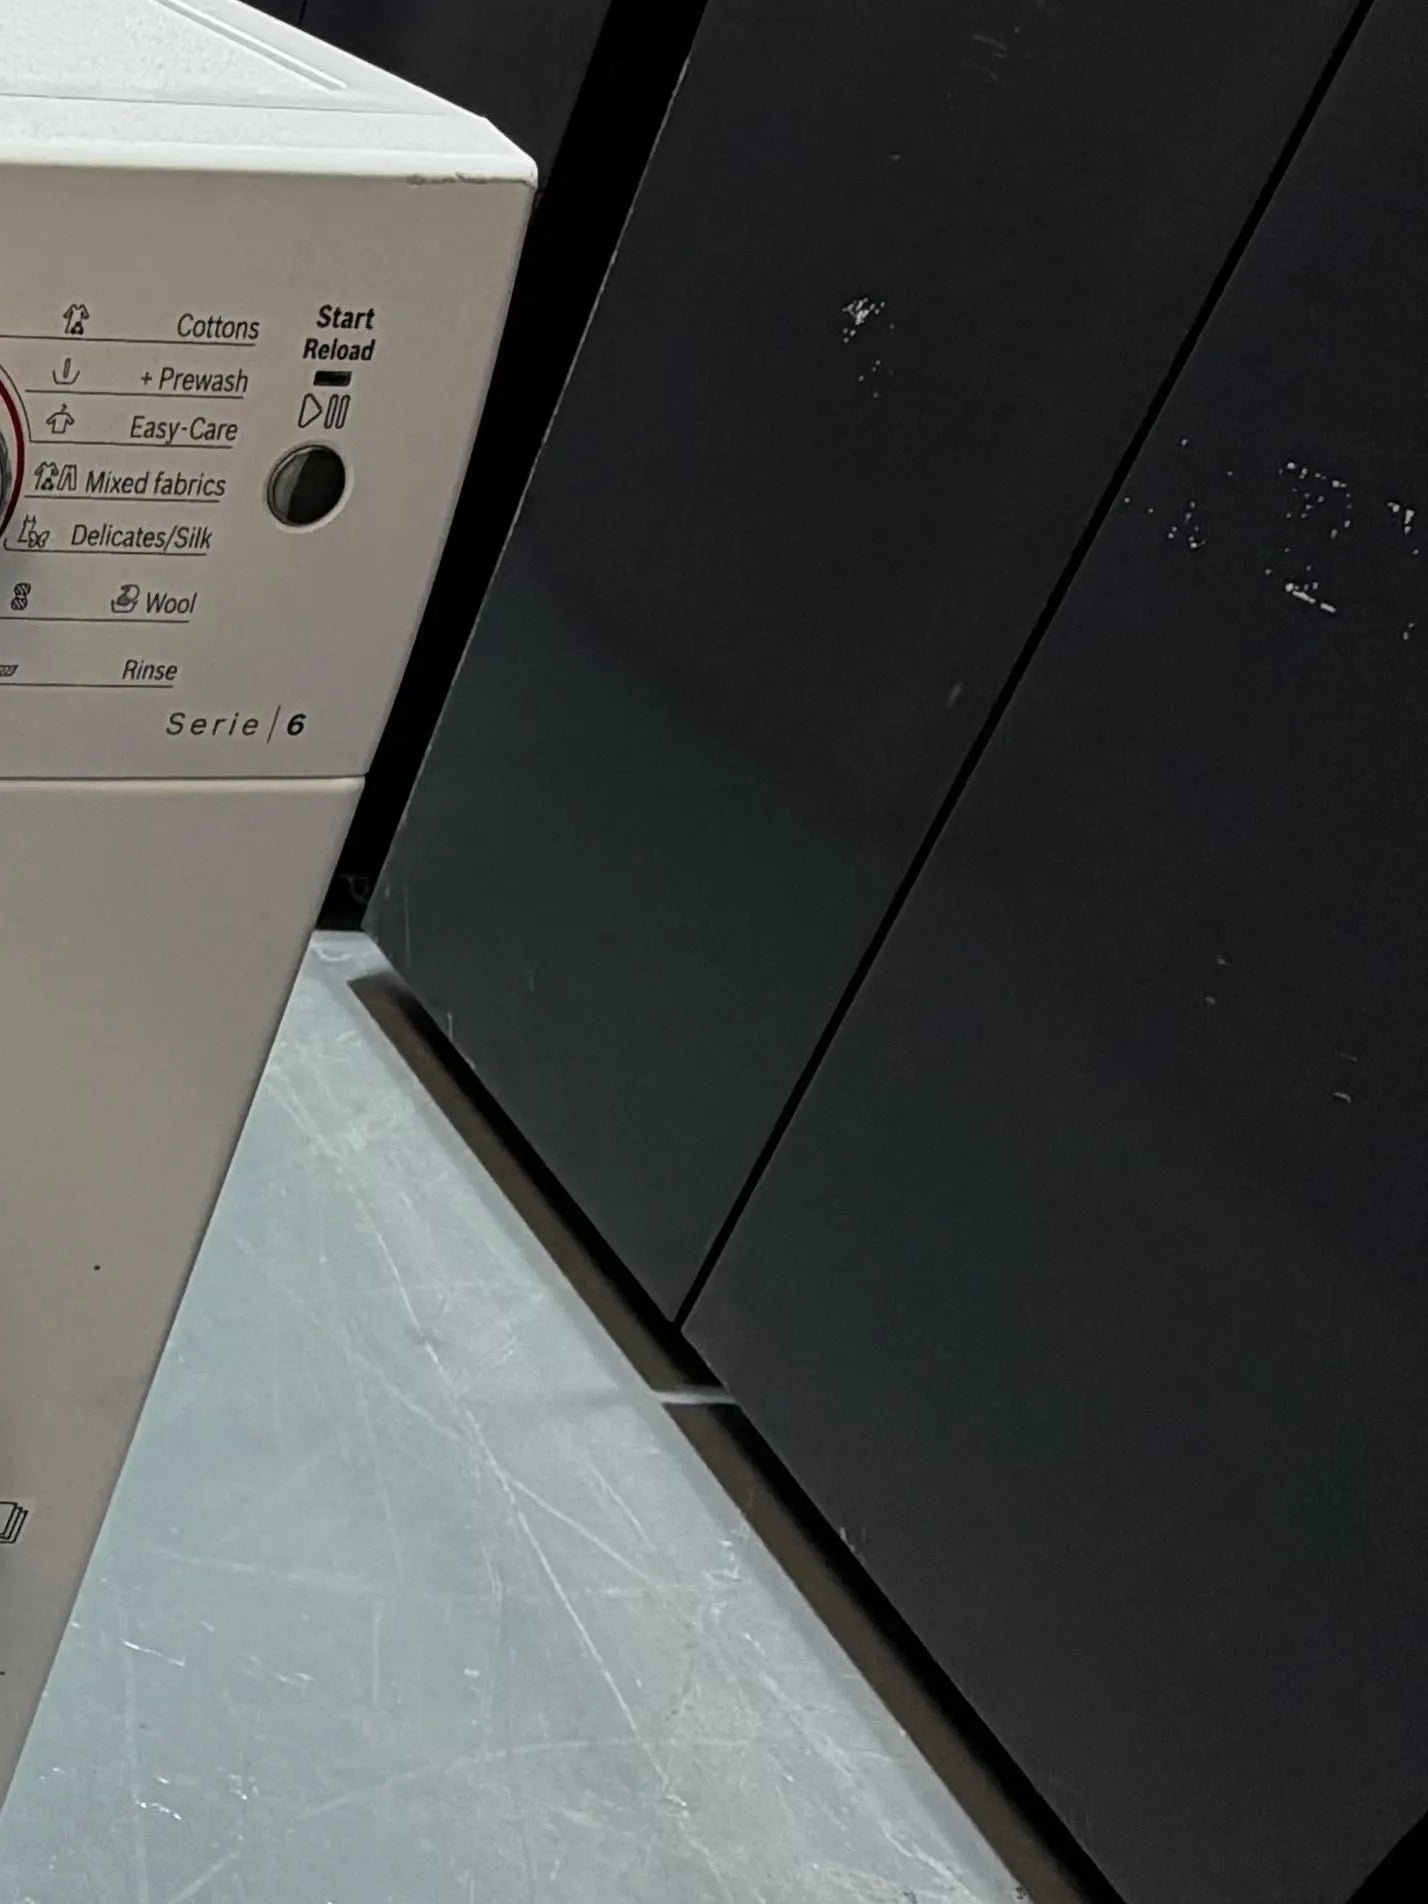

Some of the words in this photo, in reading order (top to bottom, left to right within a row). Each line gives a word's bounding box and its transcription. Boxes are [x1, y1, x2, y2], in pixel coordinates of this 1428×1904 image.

[176, 313, 260, 340] Cottons
[316, 304, 375, 330] Start
[302, 337, 376, 361] Reload
[158, 366, 249, 394] Prewash
[129, 415, 238, 444] Easy-Care
[85, 470, 151, 495] Mixed
[152, 471, 226, 497] fabrics
[70, 523, 213, 552] Delicates/Silk
[144, 592, 198, 615] Wool
[121, 659, 178, 681] Rinse
[165, 712, 259, 736] Serie
[286, 713, 307, 736] 6
